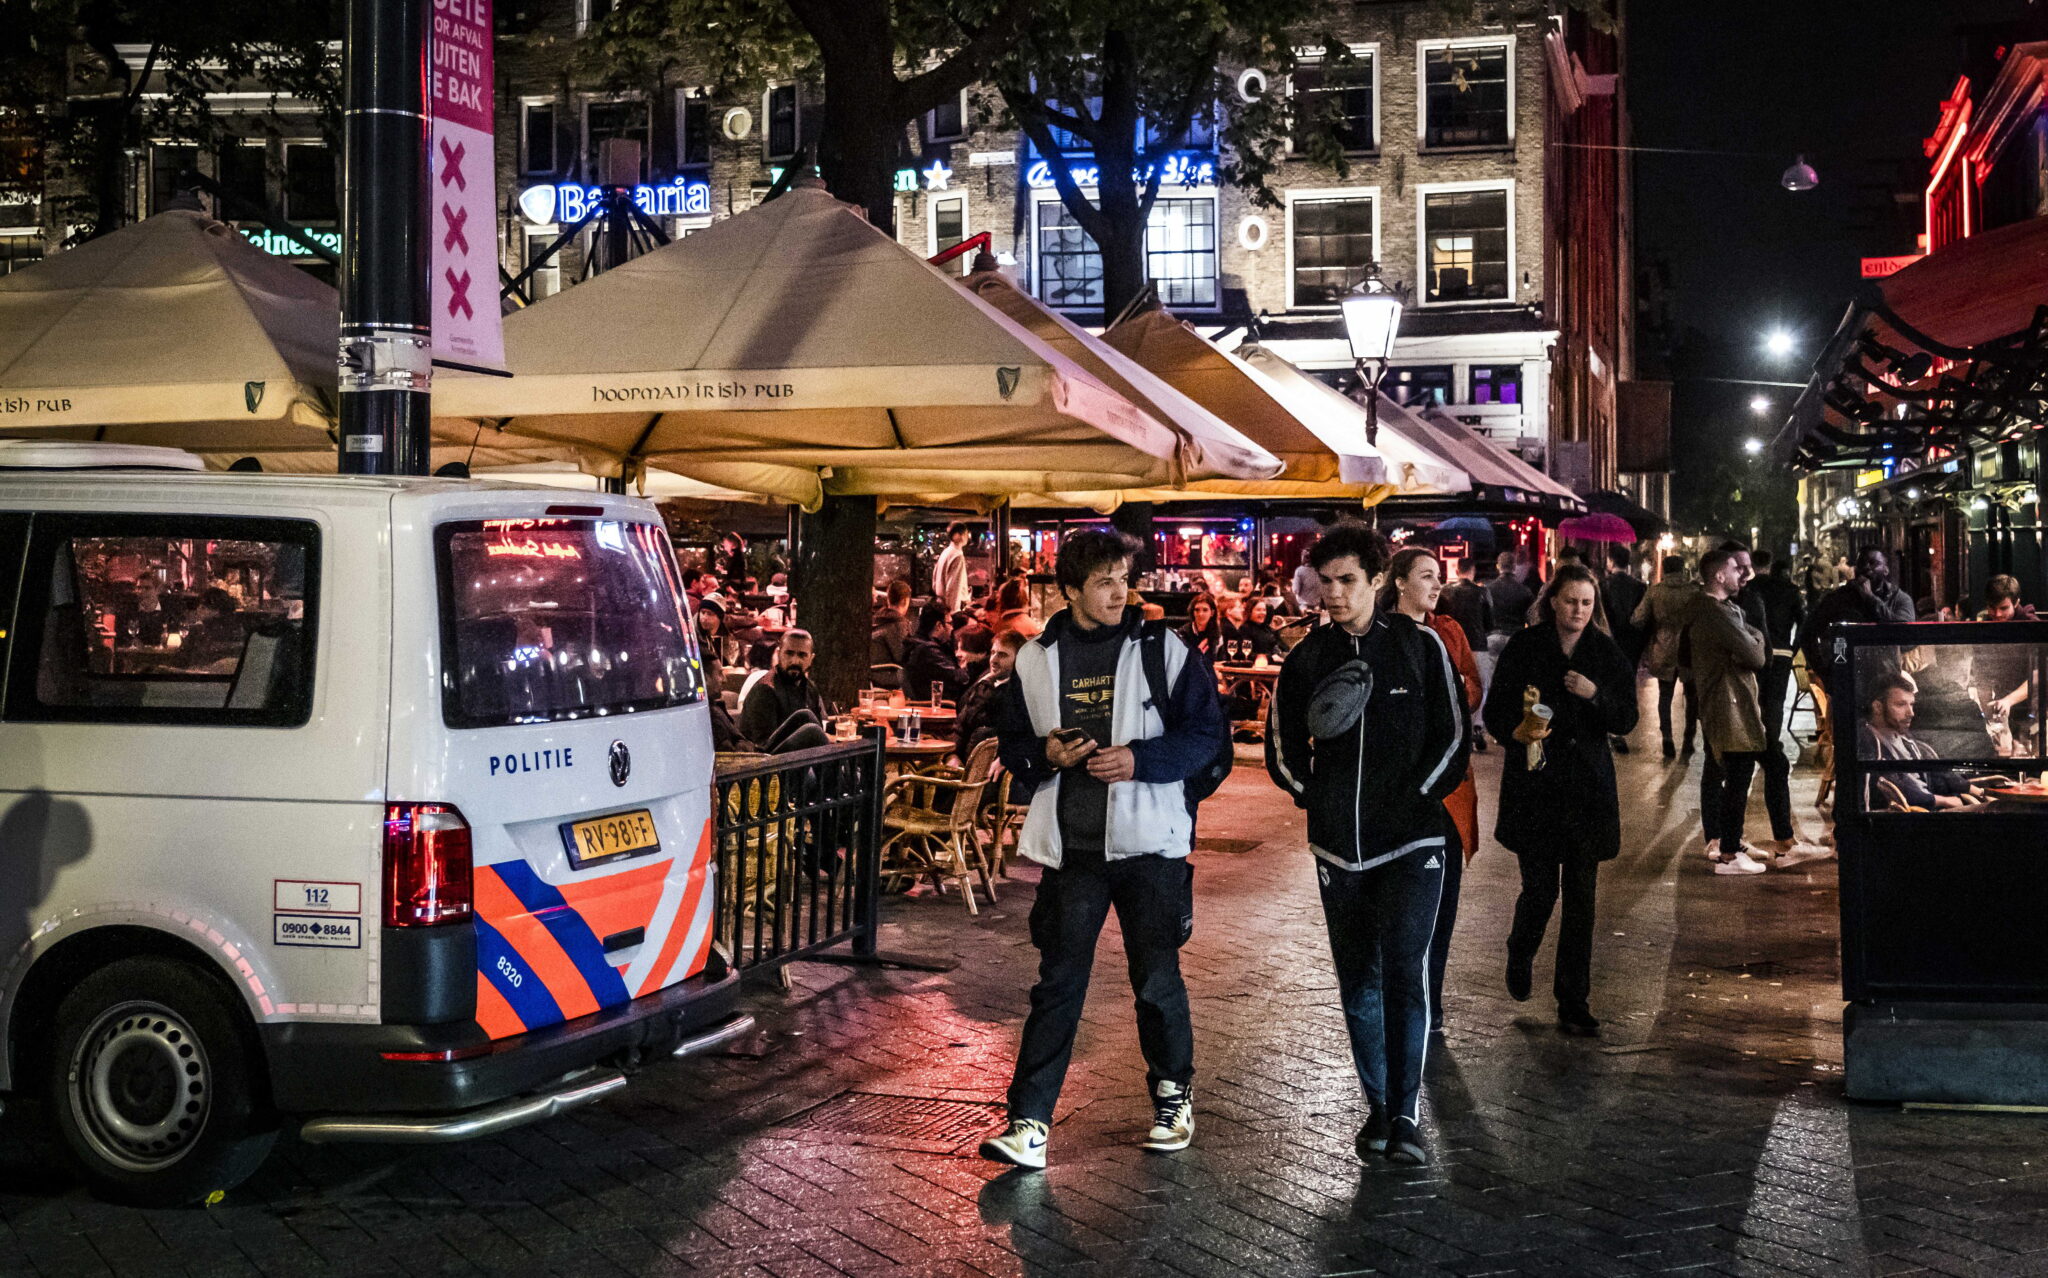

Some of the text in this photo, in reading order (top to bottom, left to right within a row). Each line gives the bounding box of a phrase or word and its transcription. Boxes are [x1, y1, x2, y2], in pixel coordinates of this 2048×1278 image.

[452, 23, 483, 49] AFVAL
[448, 76, 482, 112] BAK
[558, 177, 710, 223] Baaria
[37, 399, 72, 412] PUB
[753, 385, 793, 398] PUB
[489, 747, 573, 776] POLITIE
[581, 816, 649, 854] RV-981-F
[282, 922, 351, 936] 0900 8844
[497, 955, 522, 988] 8320
